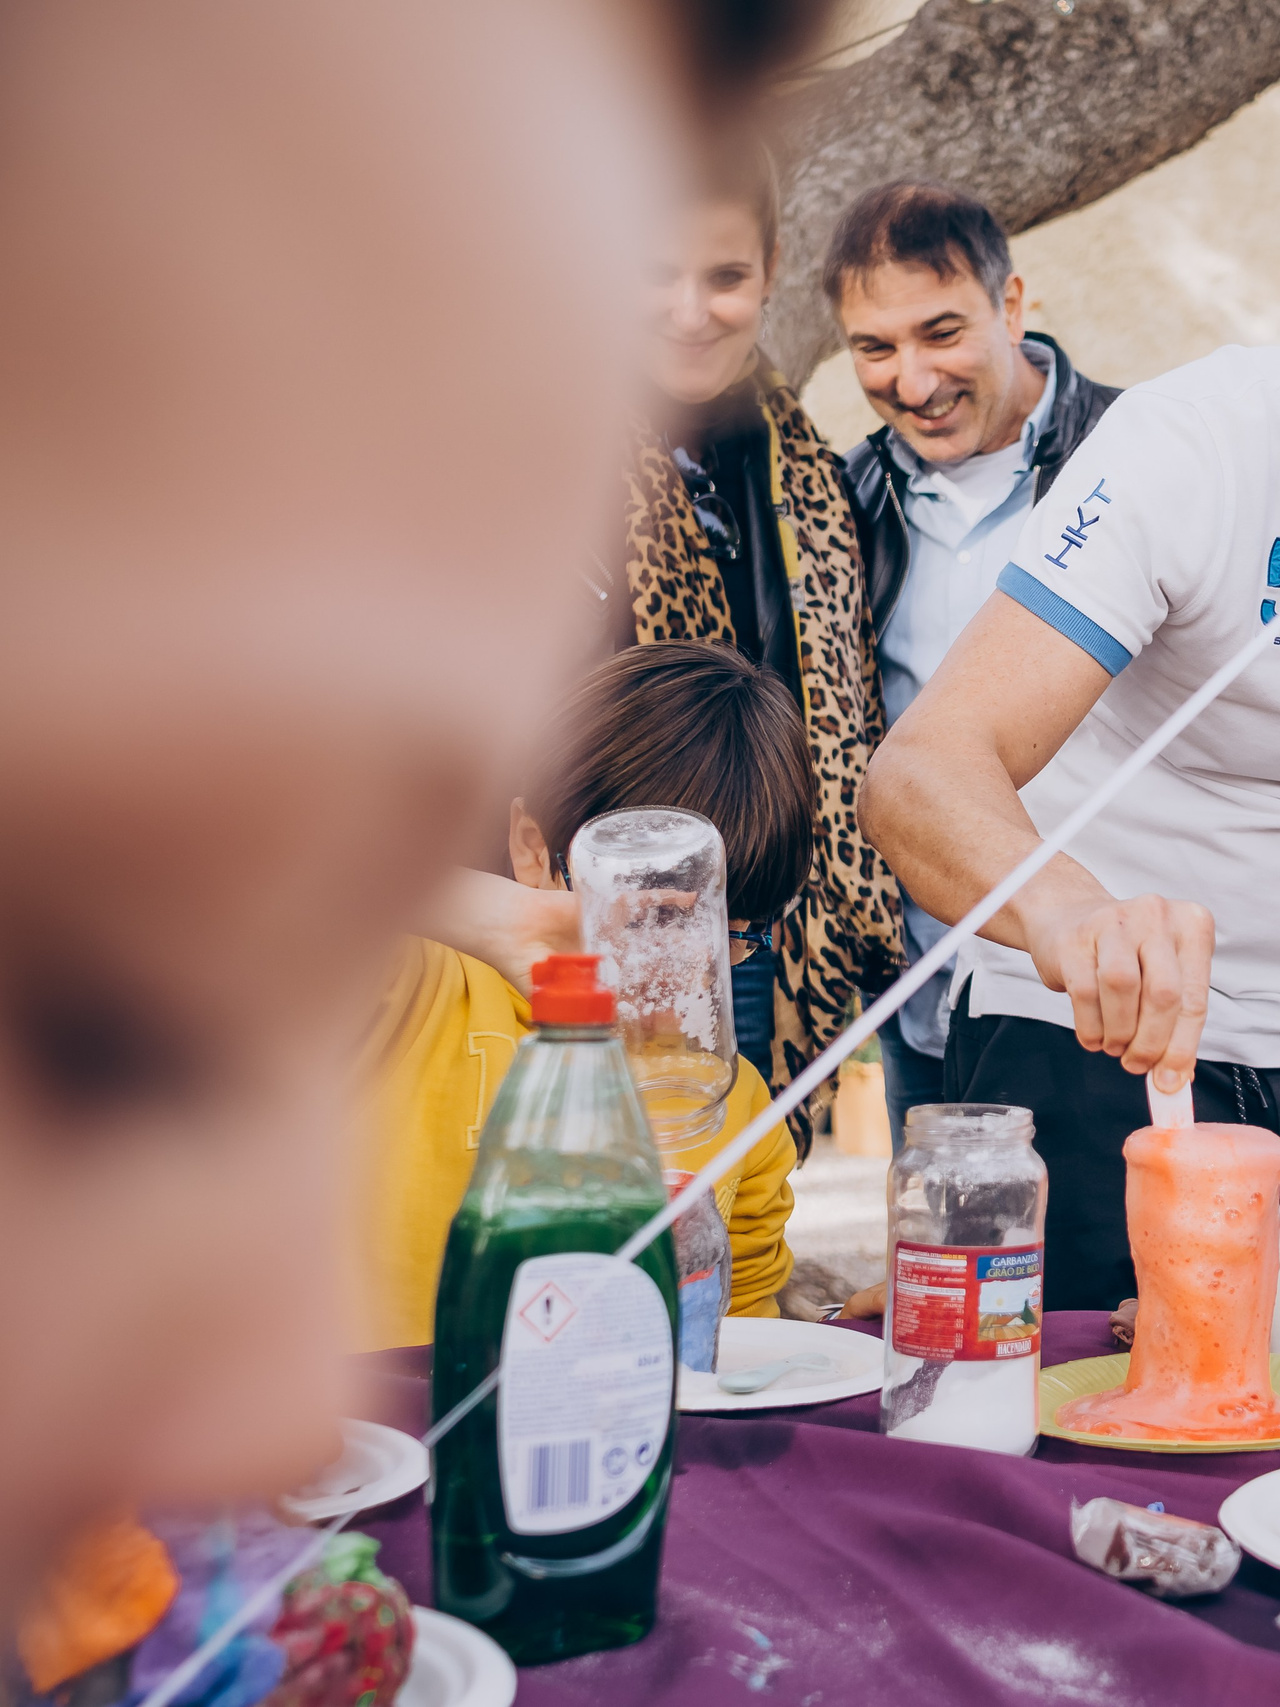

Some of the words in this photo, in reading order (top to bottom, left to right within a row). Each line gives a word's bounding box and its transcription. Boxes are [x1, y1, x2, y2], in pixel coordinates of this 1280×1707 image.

[992, 1253, 1038, 1267] GARBANZOS
[987, 1266, 1014, 1278] GRÃO
[1016, 1266, 1025, 1275] DE
